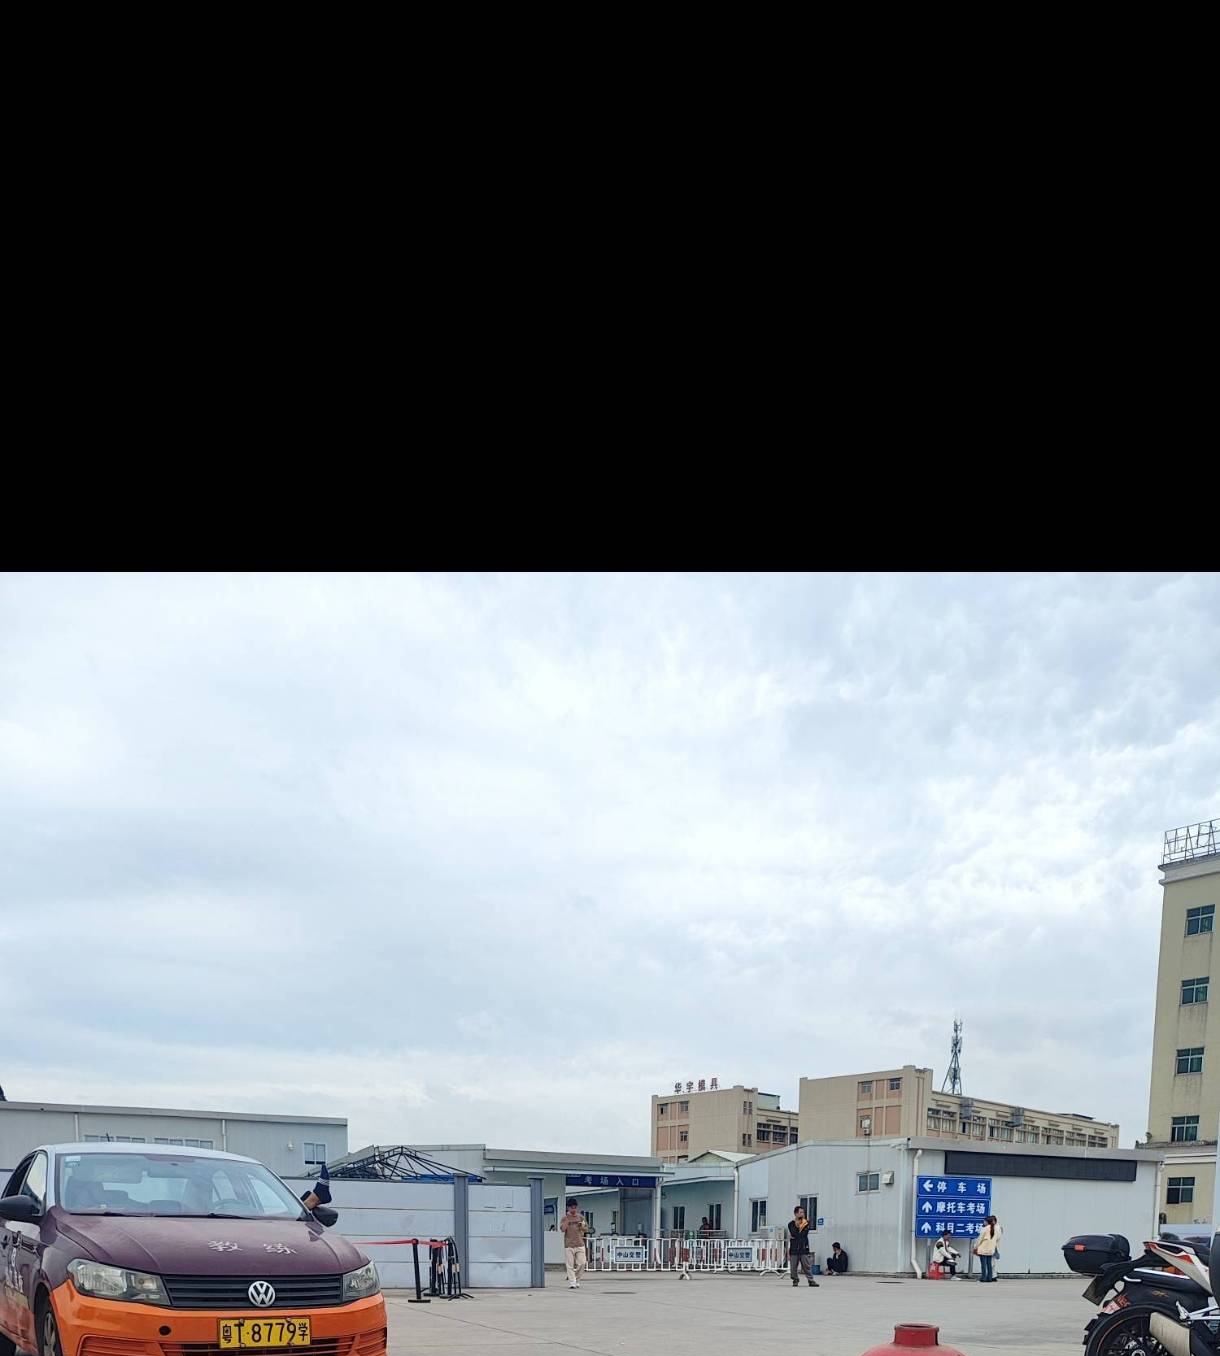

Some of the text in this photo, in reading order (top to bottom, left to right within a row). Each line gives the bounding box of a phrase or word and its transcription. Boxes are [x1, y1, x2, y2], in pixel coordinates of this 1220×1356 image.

[674, 1077, 718, 1094] 华宇模具
[584, 1175, 640, 1186] 考场入口
[937, 1181, 986, 1194] 停车场
[936, 1201, 986, 1214] 摩托车考场
[935, 1221, 984, 1234] 科目二考场
[207, 1240, 298, 1255] 教练
